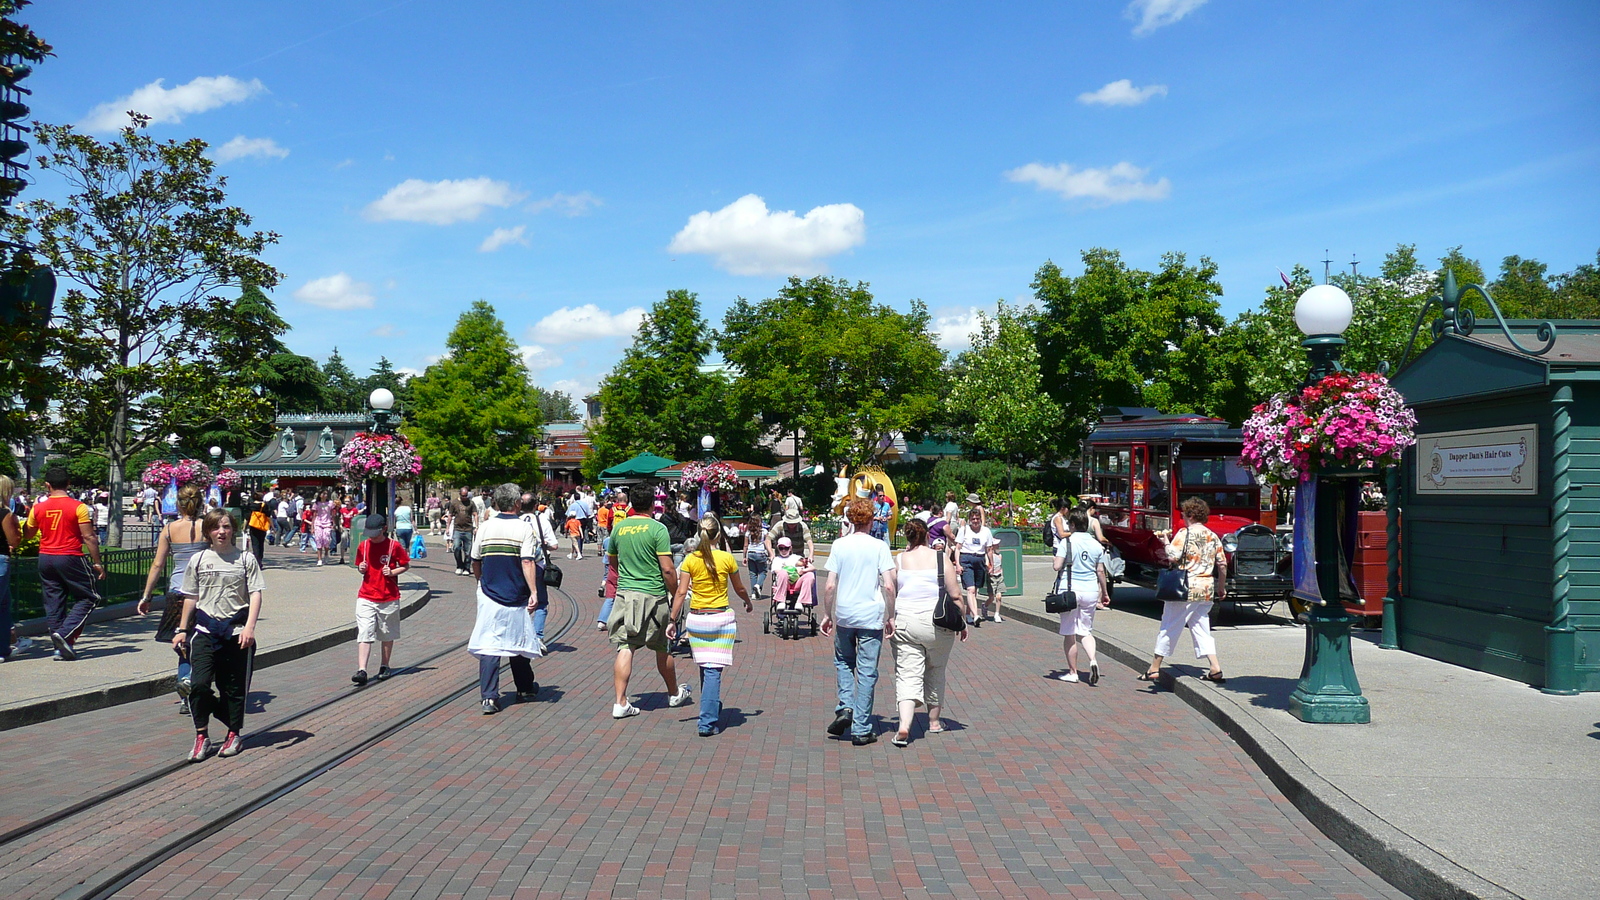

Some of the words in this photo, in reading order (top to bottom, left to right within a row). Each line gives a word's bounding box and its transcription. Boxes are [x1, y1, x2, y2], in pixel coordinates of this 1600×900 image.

[1449, 453, 1468, 462] Dapper
[1484, 451, 1497, 459] Hair
[1498, 450, 1512, 458] Cuts
[46, 510, 62, 530] 7
[1081, 550, 1088, 561] 6
